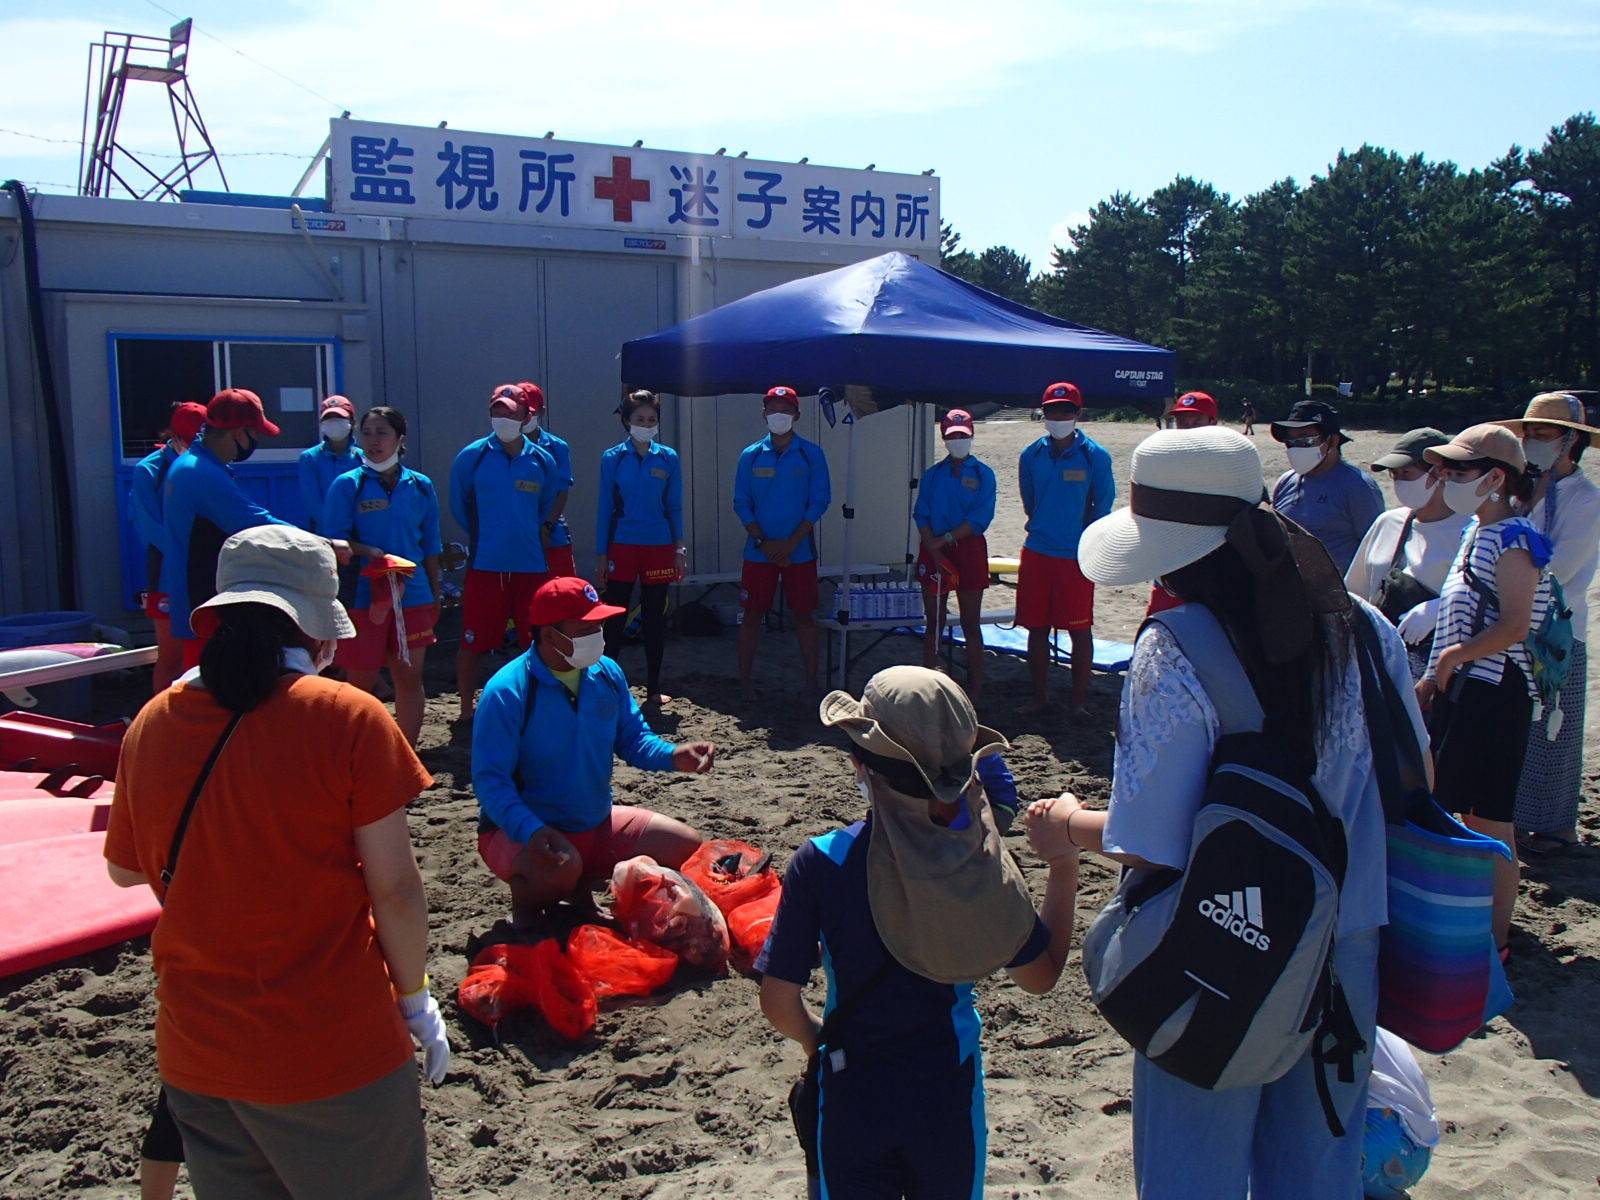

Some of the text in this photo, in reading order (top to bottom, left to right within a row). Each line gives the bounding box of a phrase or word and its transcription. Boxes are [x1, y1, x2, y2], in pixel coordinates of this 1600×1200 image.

[350, 135, 930, 242] 監視所 迷子案内所
[1114, 369, 1164, 380] CAPTAIN STAG
[1198, 899, 1271, 951] adidas
